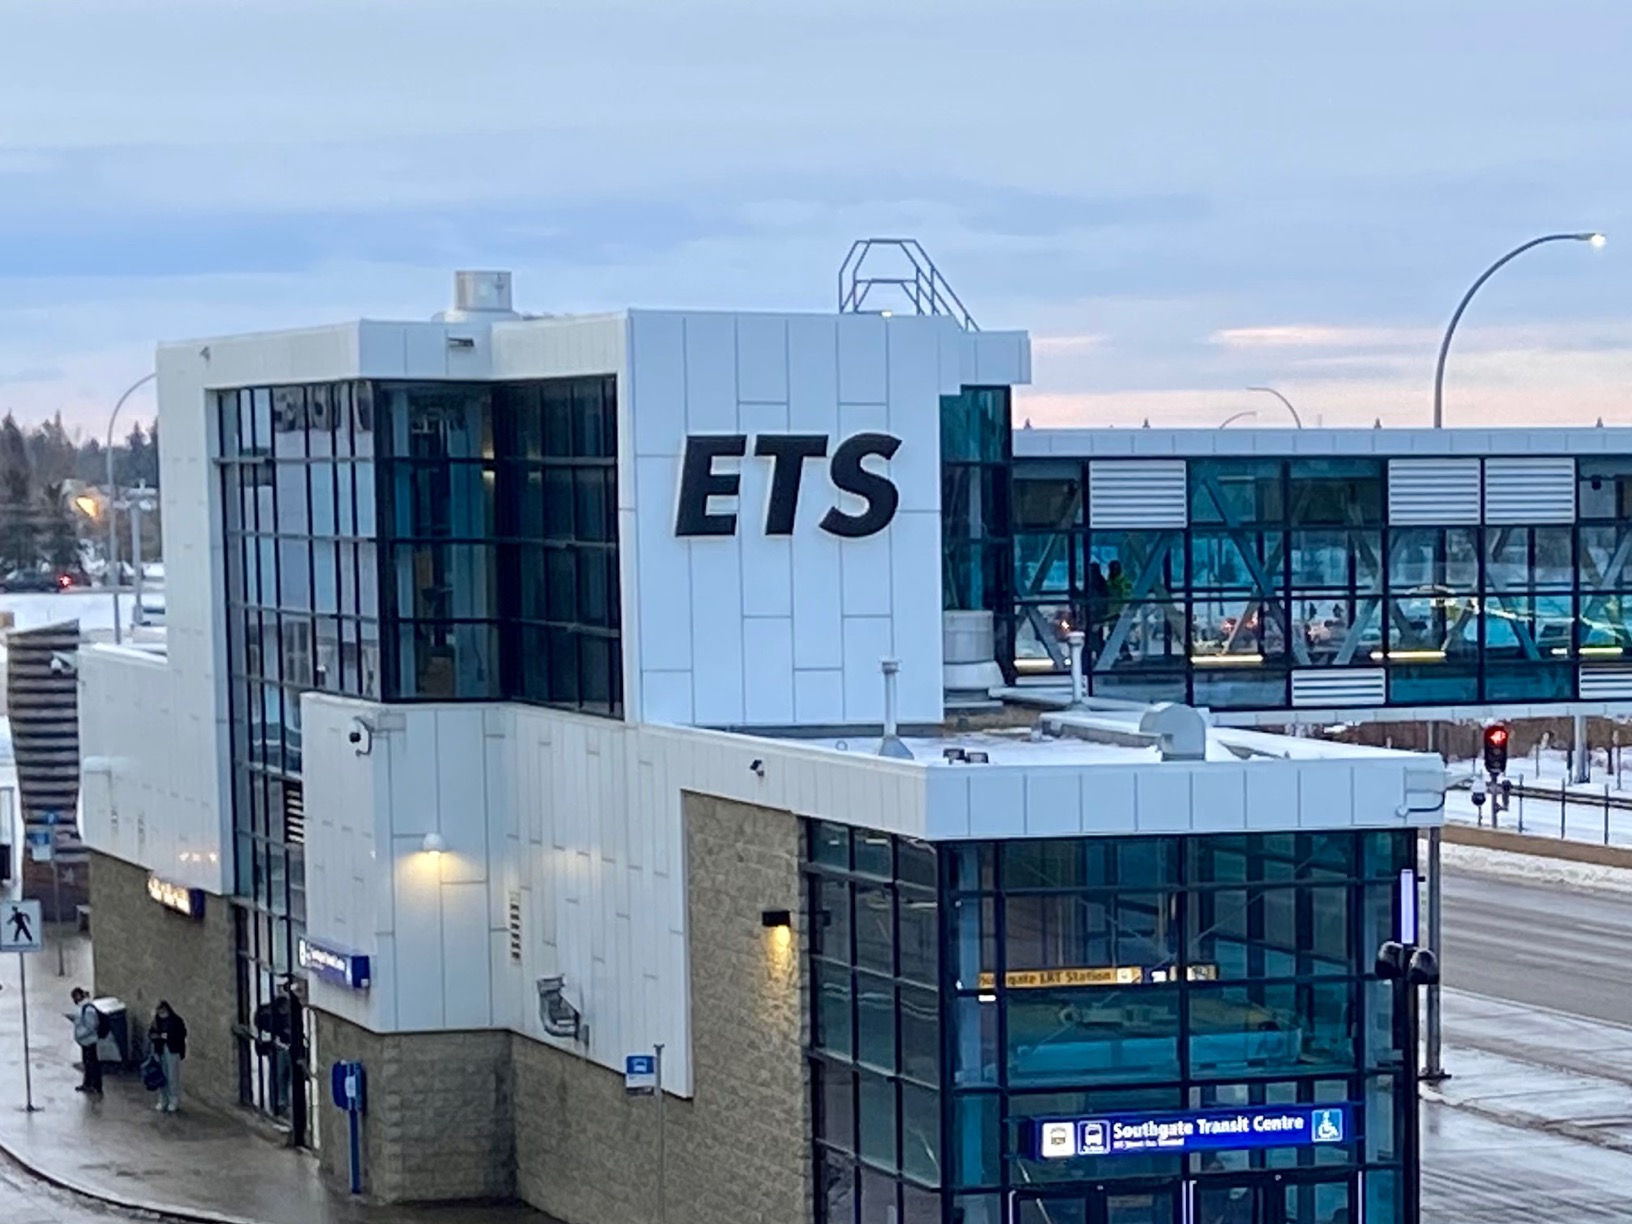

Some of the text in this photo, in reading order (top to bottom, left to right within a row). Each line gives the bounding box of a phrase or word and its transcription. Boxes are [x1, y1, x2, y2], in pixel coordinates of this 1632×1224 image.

[675, 432, 903, 538] ETS
[1112, 1115, 1305, 1140] Southgate Transit Centre
